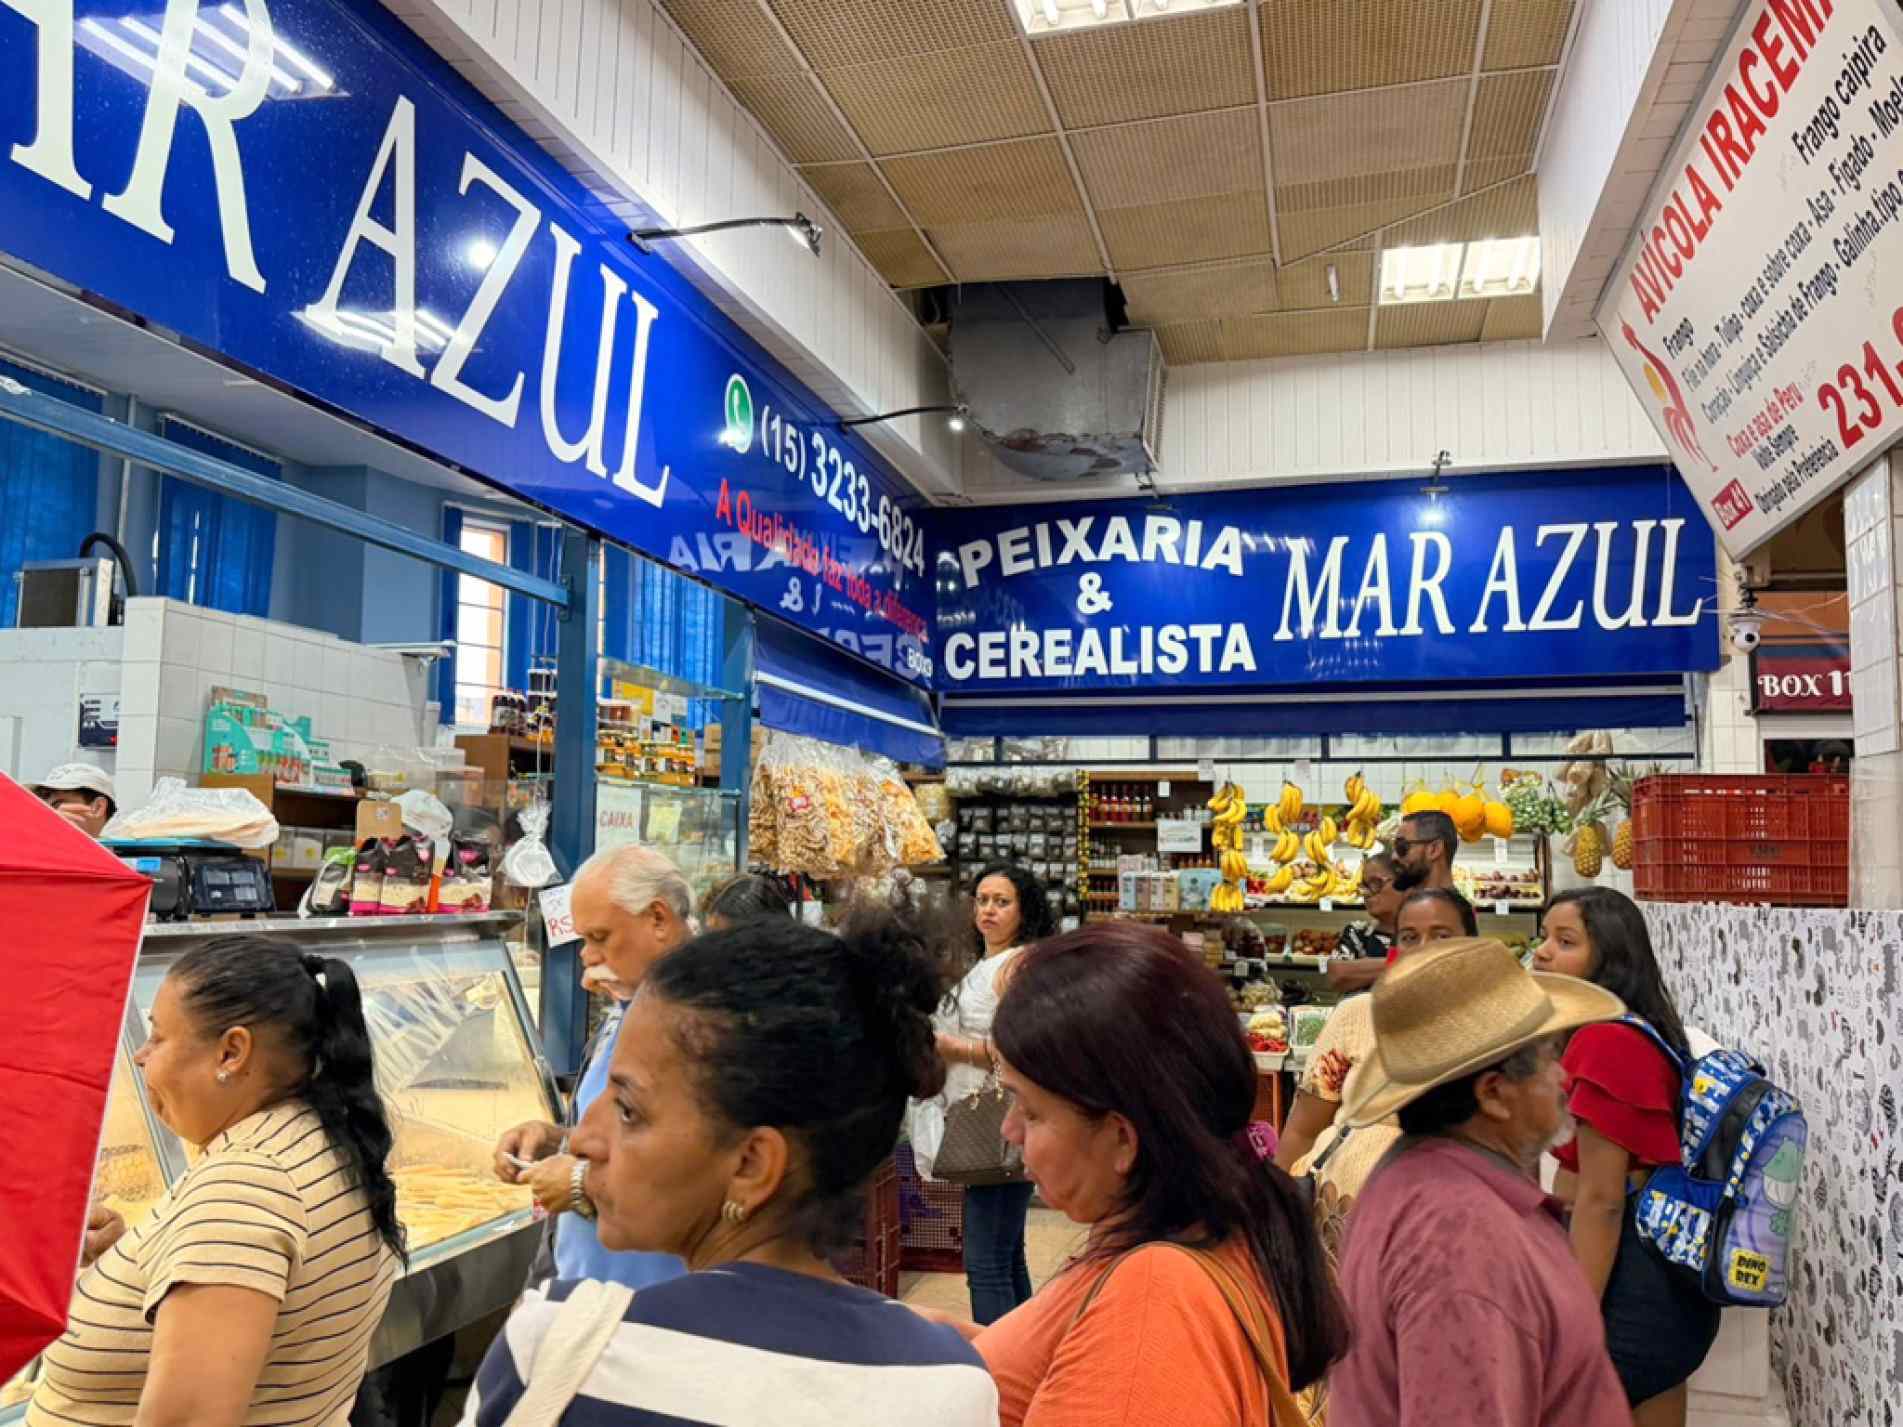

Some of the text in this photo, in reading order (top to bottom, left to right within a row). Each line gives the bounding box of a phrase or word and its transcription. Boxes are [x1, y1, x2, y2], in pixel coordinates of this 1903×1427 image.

[1791, 25, 1887, 165] Frango caipira
[1630, 164, 1723, 325] AVÍCOLA
[1763, 249, 1790, 288] sobre
[1784, 222, 1812, 260] coxa
[1807, 194, 1834, 228] Asa
[1797, 262, 1838, 309] Frango
[305, 94, 669, 508] AZUL
[716, 478, 733, 527] A
[738, 490, 819, 576] Qualidade
[761, 405, 925, 577] (15) 3233-6824
[958, 514, 1244, 589] PEIXARIA
[1075, 571, 1113, 614] &
[1273, 518, 1703, 641] MAR AZUL
[945, 623, 1257, 681] CEREALISTA
[1758, 673, 1823, 697] BOX
